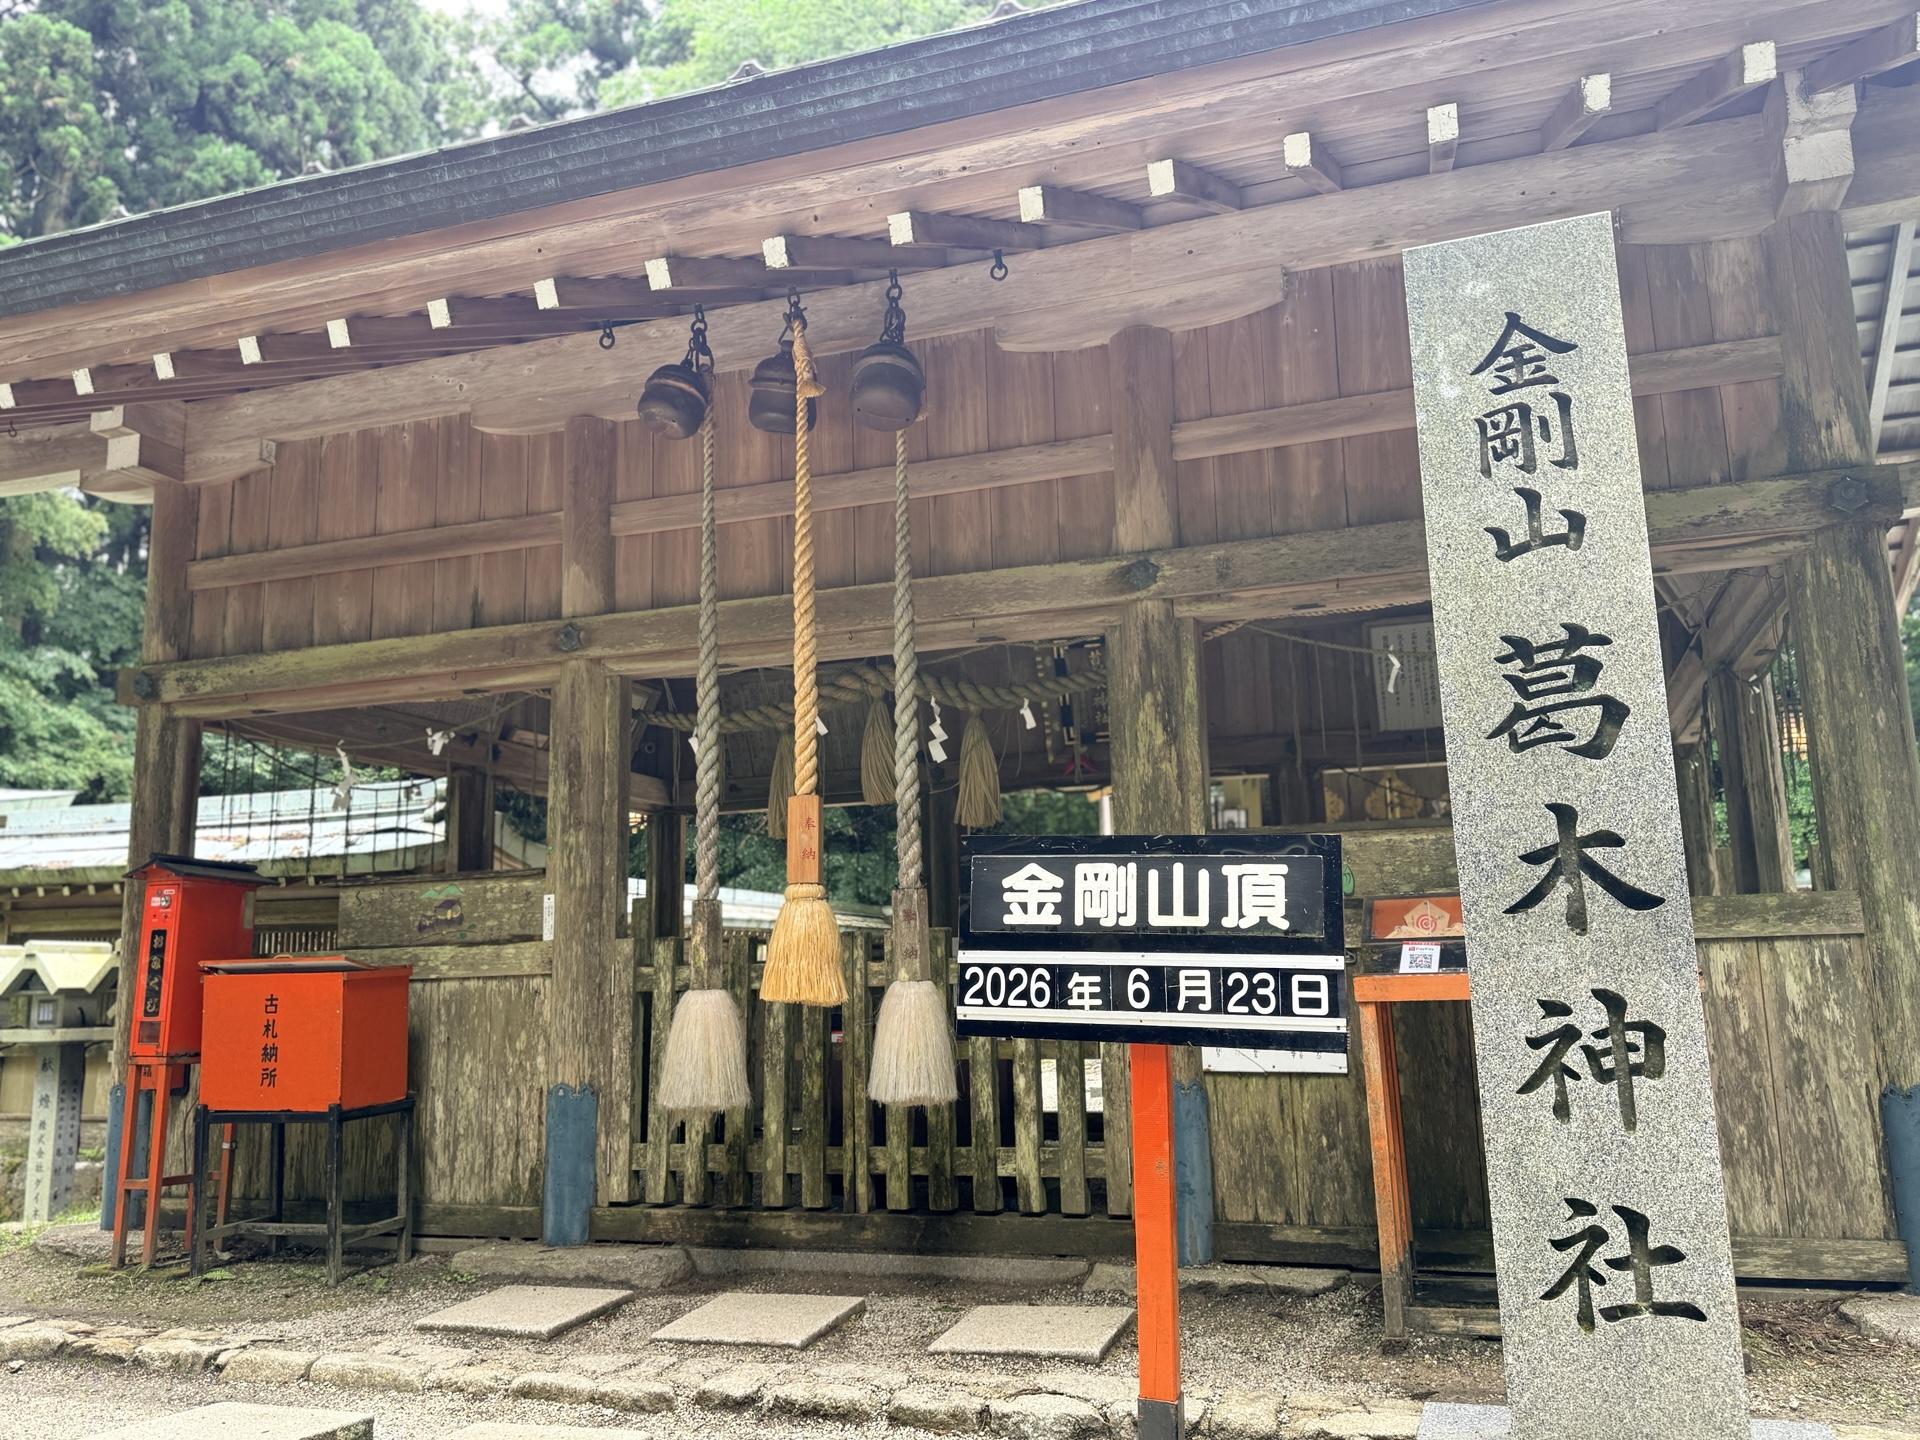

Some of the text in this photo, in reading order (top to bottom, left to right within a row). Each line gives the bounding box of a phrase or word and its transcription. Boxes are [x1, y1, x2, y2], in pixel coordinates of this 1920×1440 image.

[801, 816, 816, 860] 奉納
[1002, 862, 1290, 931] 金剛山頂
[260, 993, 279, 1088] 古札納所
